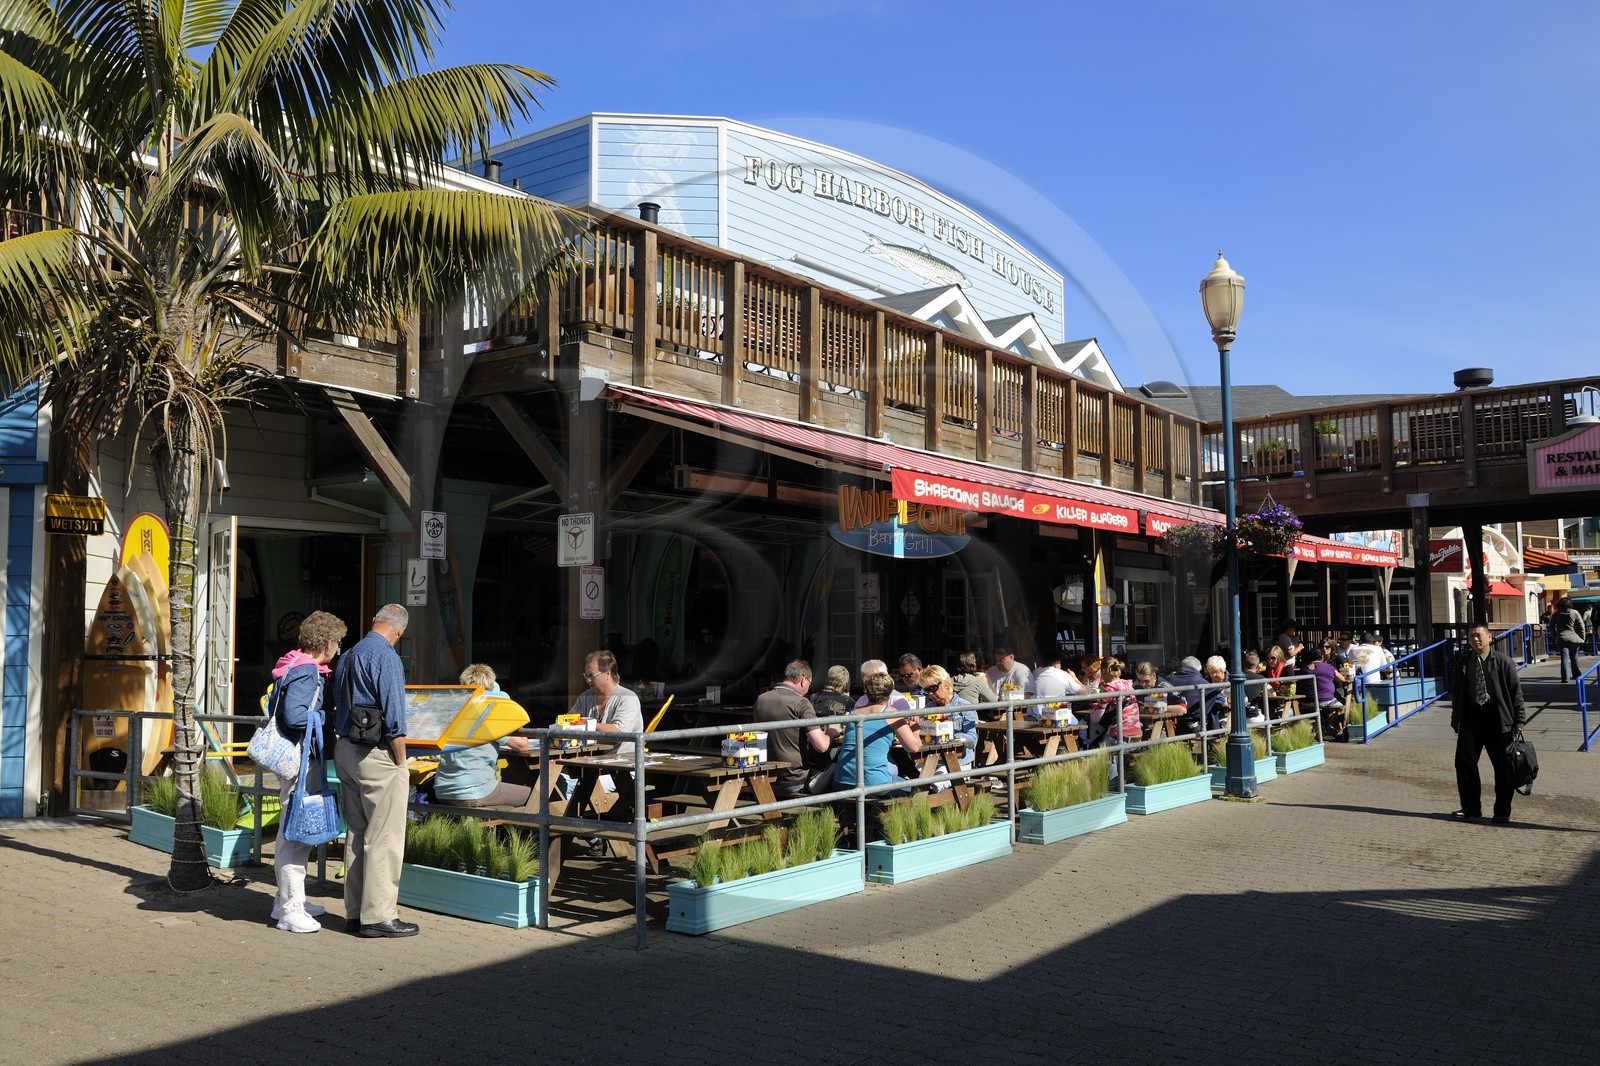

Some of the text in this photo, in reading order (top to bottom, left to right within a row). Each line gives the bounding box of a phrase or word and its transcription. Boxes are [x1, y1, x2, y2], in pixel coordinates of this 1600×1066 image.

[743, 155, 1054, 314] FOG HARBOR FISH HOUSE
[1555, 466, 1568, 476] &
[838, 485, 967, 536] WIPEOUT
[914, 479, 1128, 528] SHREDDING SALADS KILLER BURGERS
[50, 518, 99, 531] WETSUIT
[425, 521, 443, 529] TRANS
[561, 516, 591, 527] NO THONGS
[868, 528, 894, 547] Bar
[904, 531, 933, 553] Grill
[664, 571, 675, 625] Heineken
